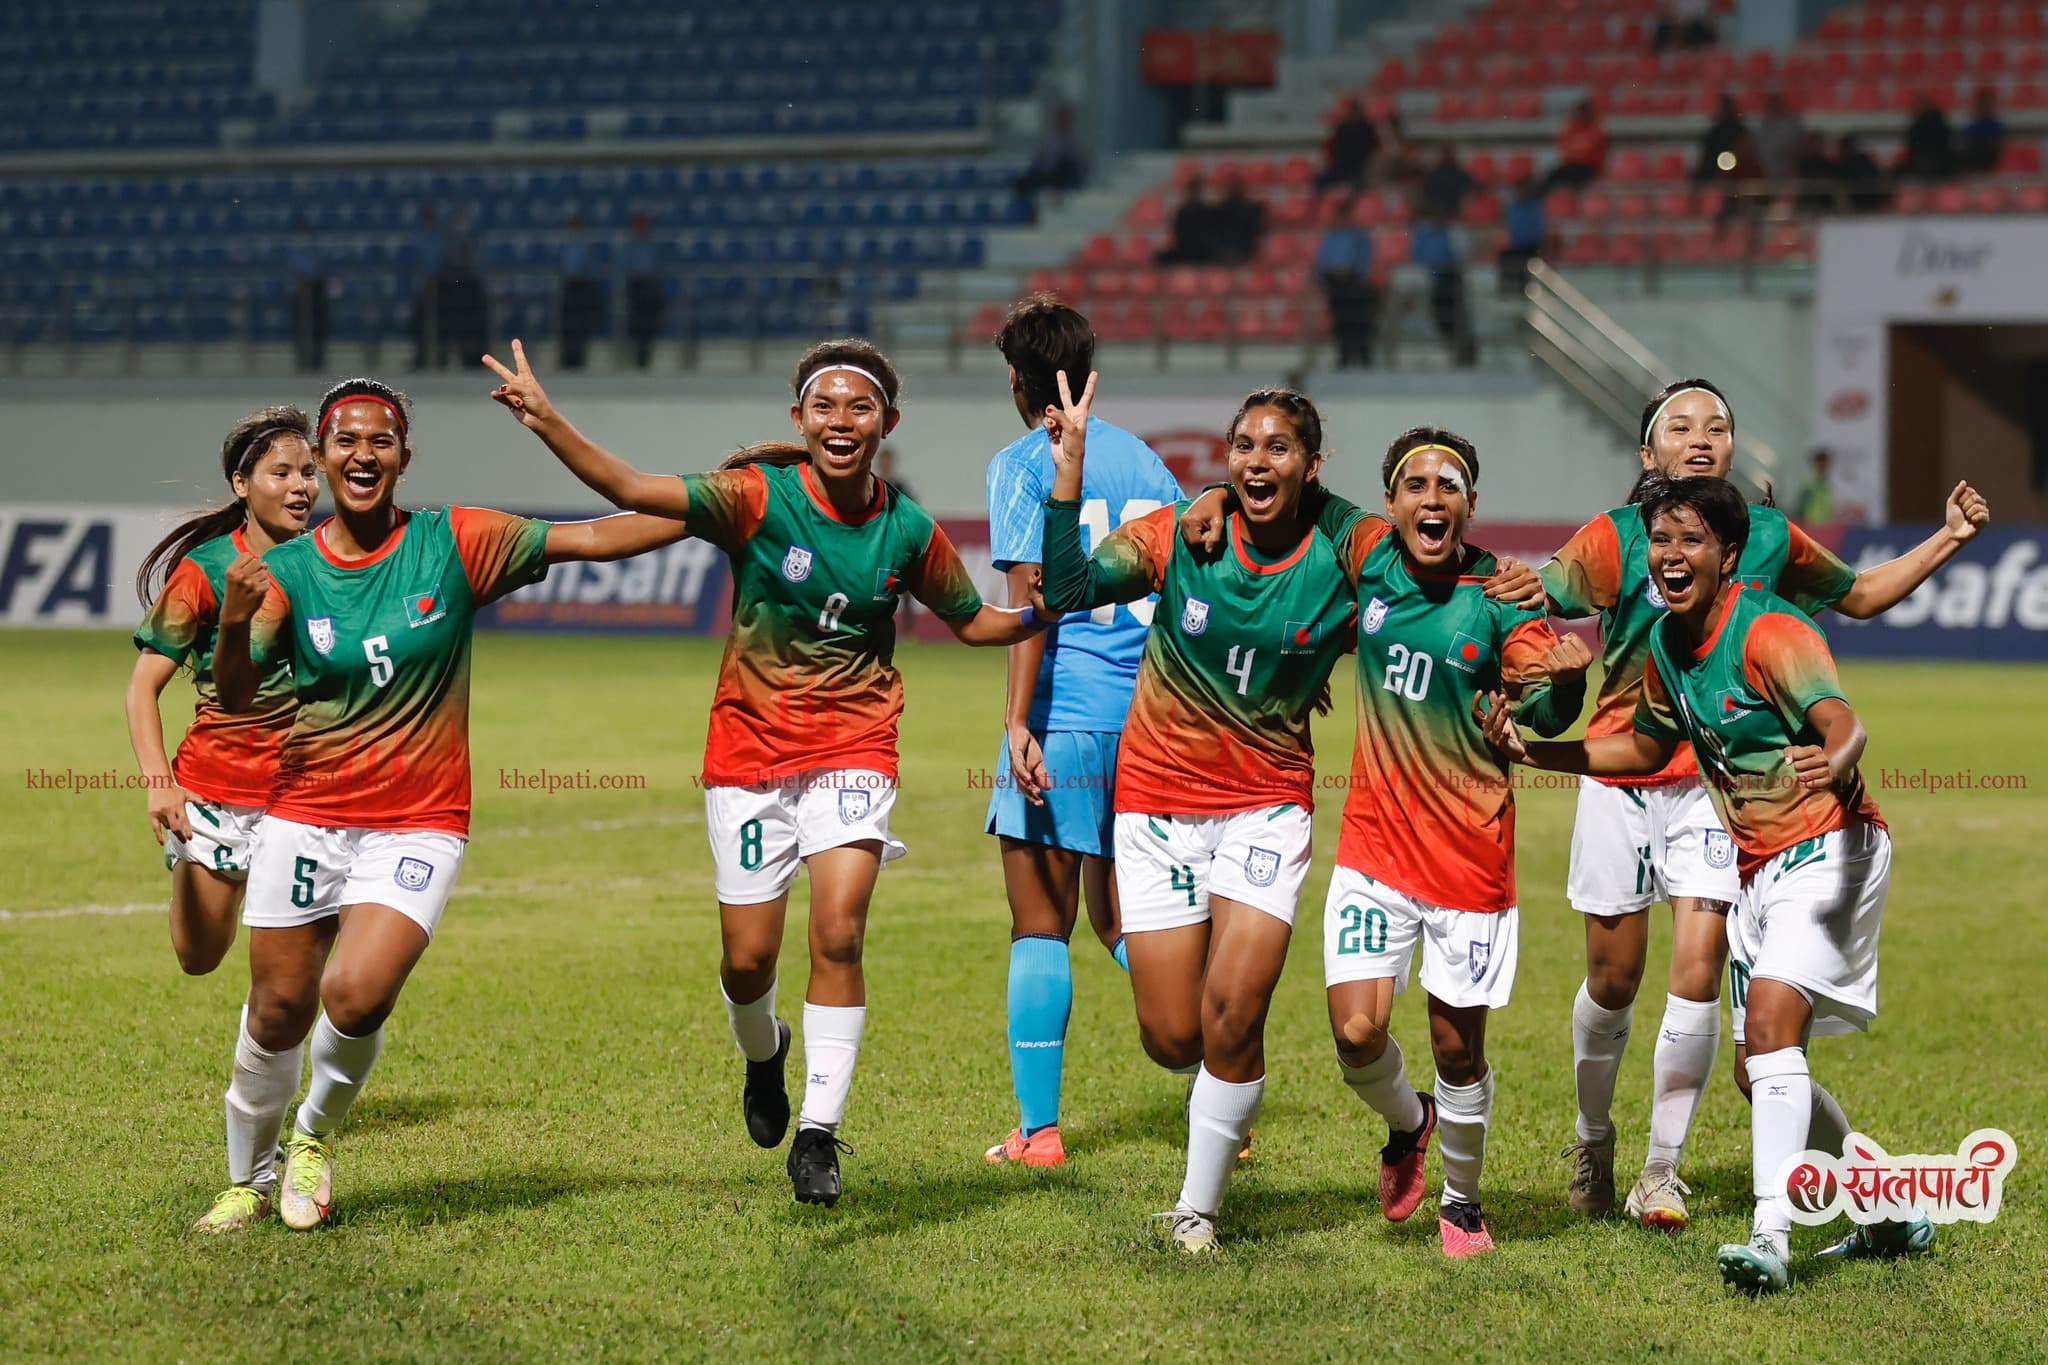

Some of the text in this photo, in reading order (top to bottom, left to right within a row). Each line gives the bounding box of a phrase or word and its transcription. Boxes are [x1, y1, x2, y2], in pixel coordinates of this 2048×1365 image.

[817, 592, 849, 633] 8
[362, 635, 395, 688] 5
[1225, 645, 1257, 696] 4
[1382, 643, 1434, 701] 20
[739, 818, 763, 872] 8
[291, 855, 318, 909] 5
[1170, 864, 1197, 907] 4
[1337, 904, 1388, 955] 20
